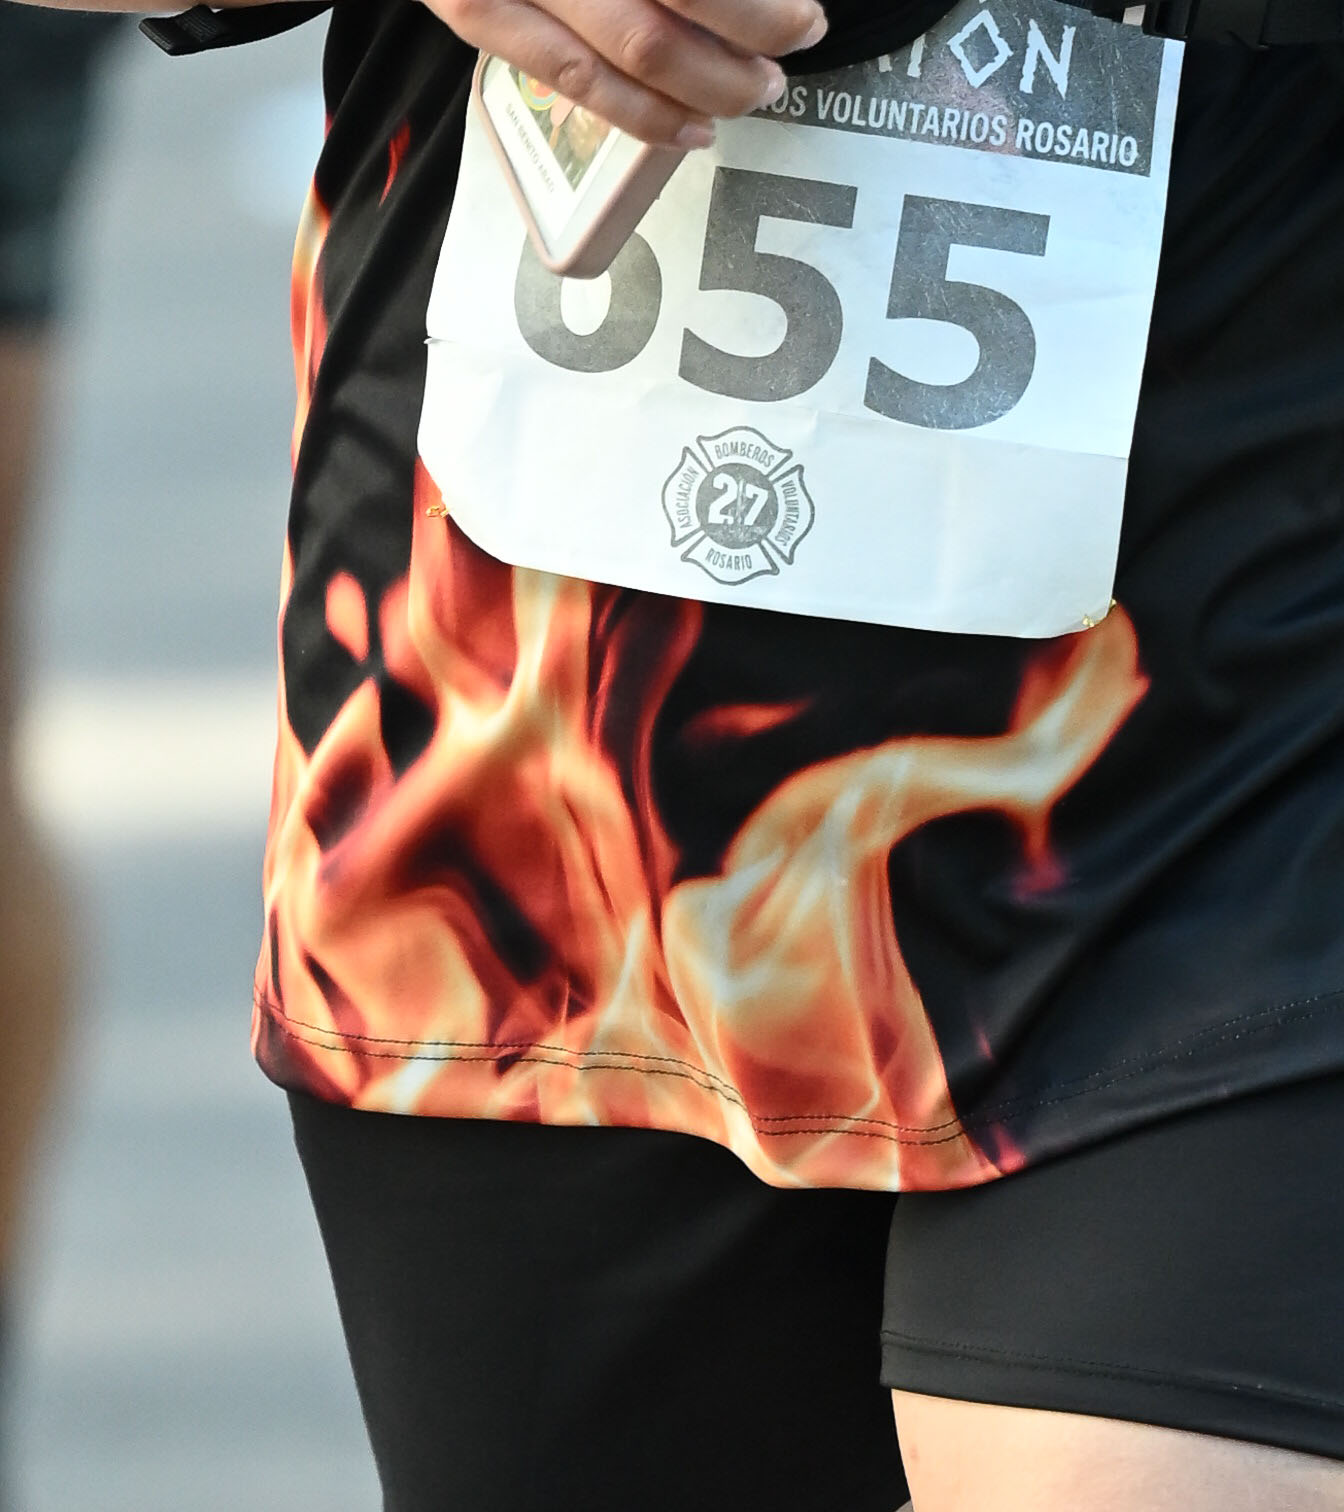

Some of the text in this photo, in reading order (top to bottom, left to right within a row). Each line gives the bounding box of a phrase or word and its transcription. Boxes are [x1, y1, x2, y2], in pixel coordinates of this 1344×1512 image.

[760, 87, 1138, 167] OS VOLUNTARIOS ROSARIO
[714, 441, 775, 467] BOMBEROS
[708, 473, 769, 526] 27
[773, 479, 800, 547] VOLUNTARIOS
[705, 548, 753, 571] ROSARIO
